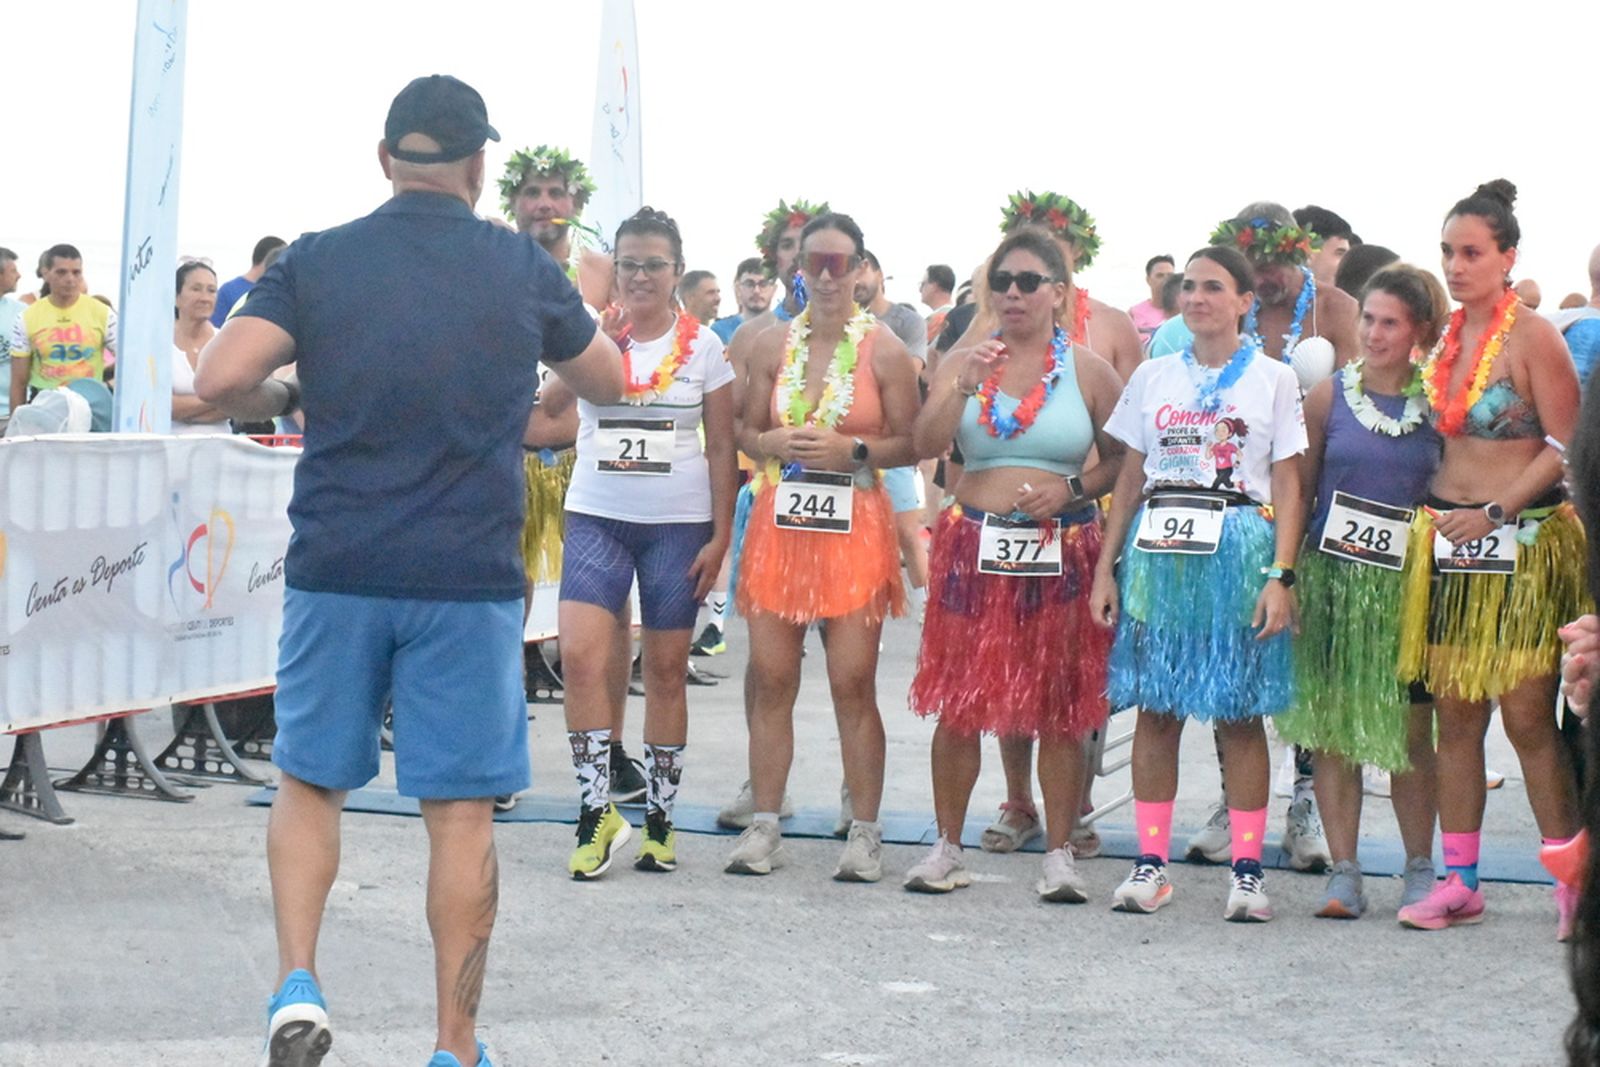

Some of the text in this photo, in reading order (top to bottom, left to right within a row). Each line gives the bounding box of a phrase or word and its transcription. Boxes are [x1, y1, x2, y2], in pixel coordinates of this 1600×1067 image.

[1155, 404, 1217, 431] Conchi
[618, 438, 649, 461] 21
[1159, 455, 1201, 471] GIGANTE
[788, 492, 836, 518] 244
[1162, 517, 1195, 540] 94
[1341, 520, 1392, 552] 248
[996, 538, 1043, 562] 377
[72, 576, 87, 595] es
[90, 541, 148, 593] Deporte
